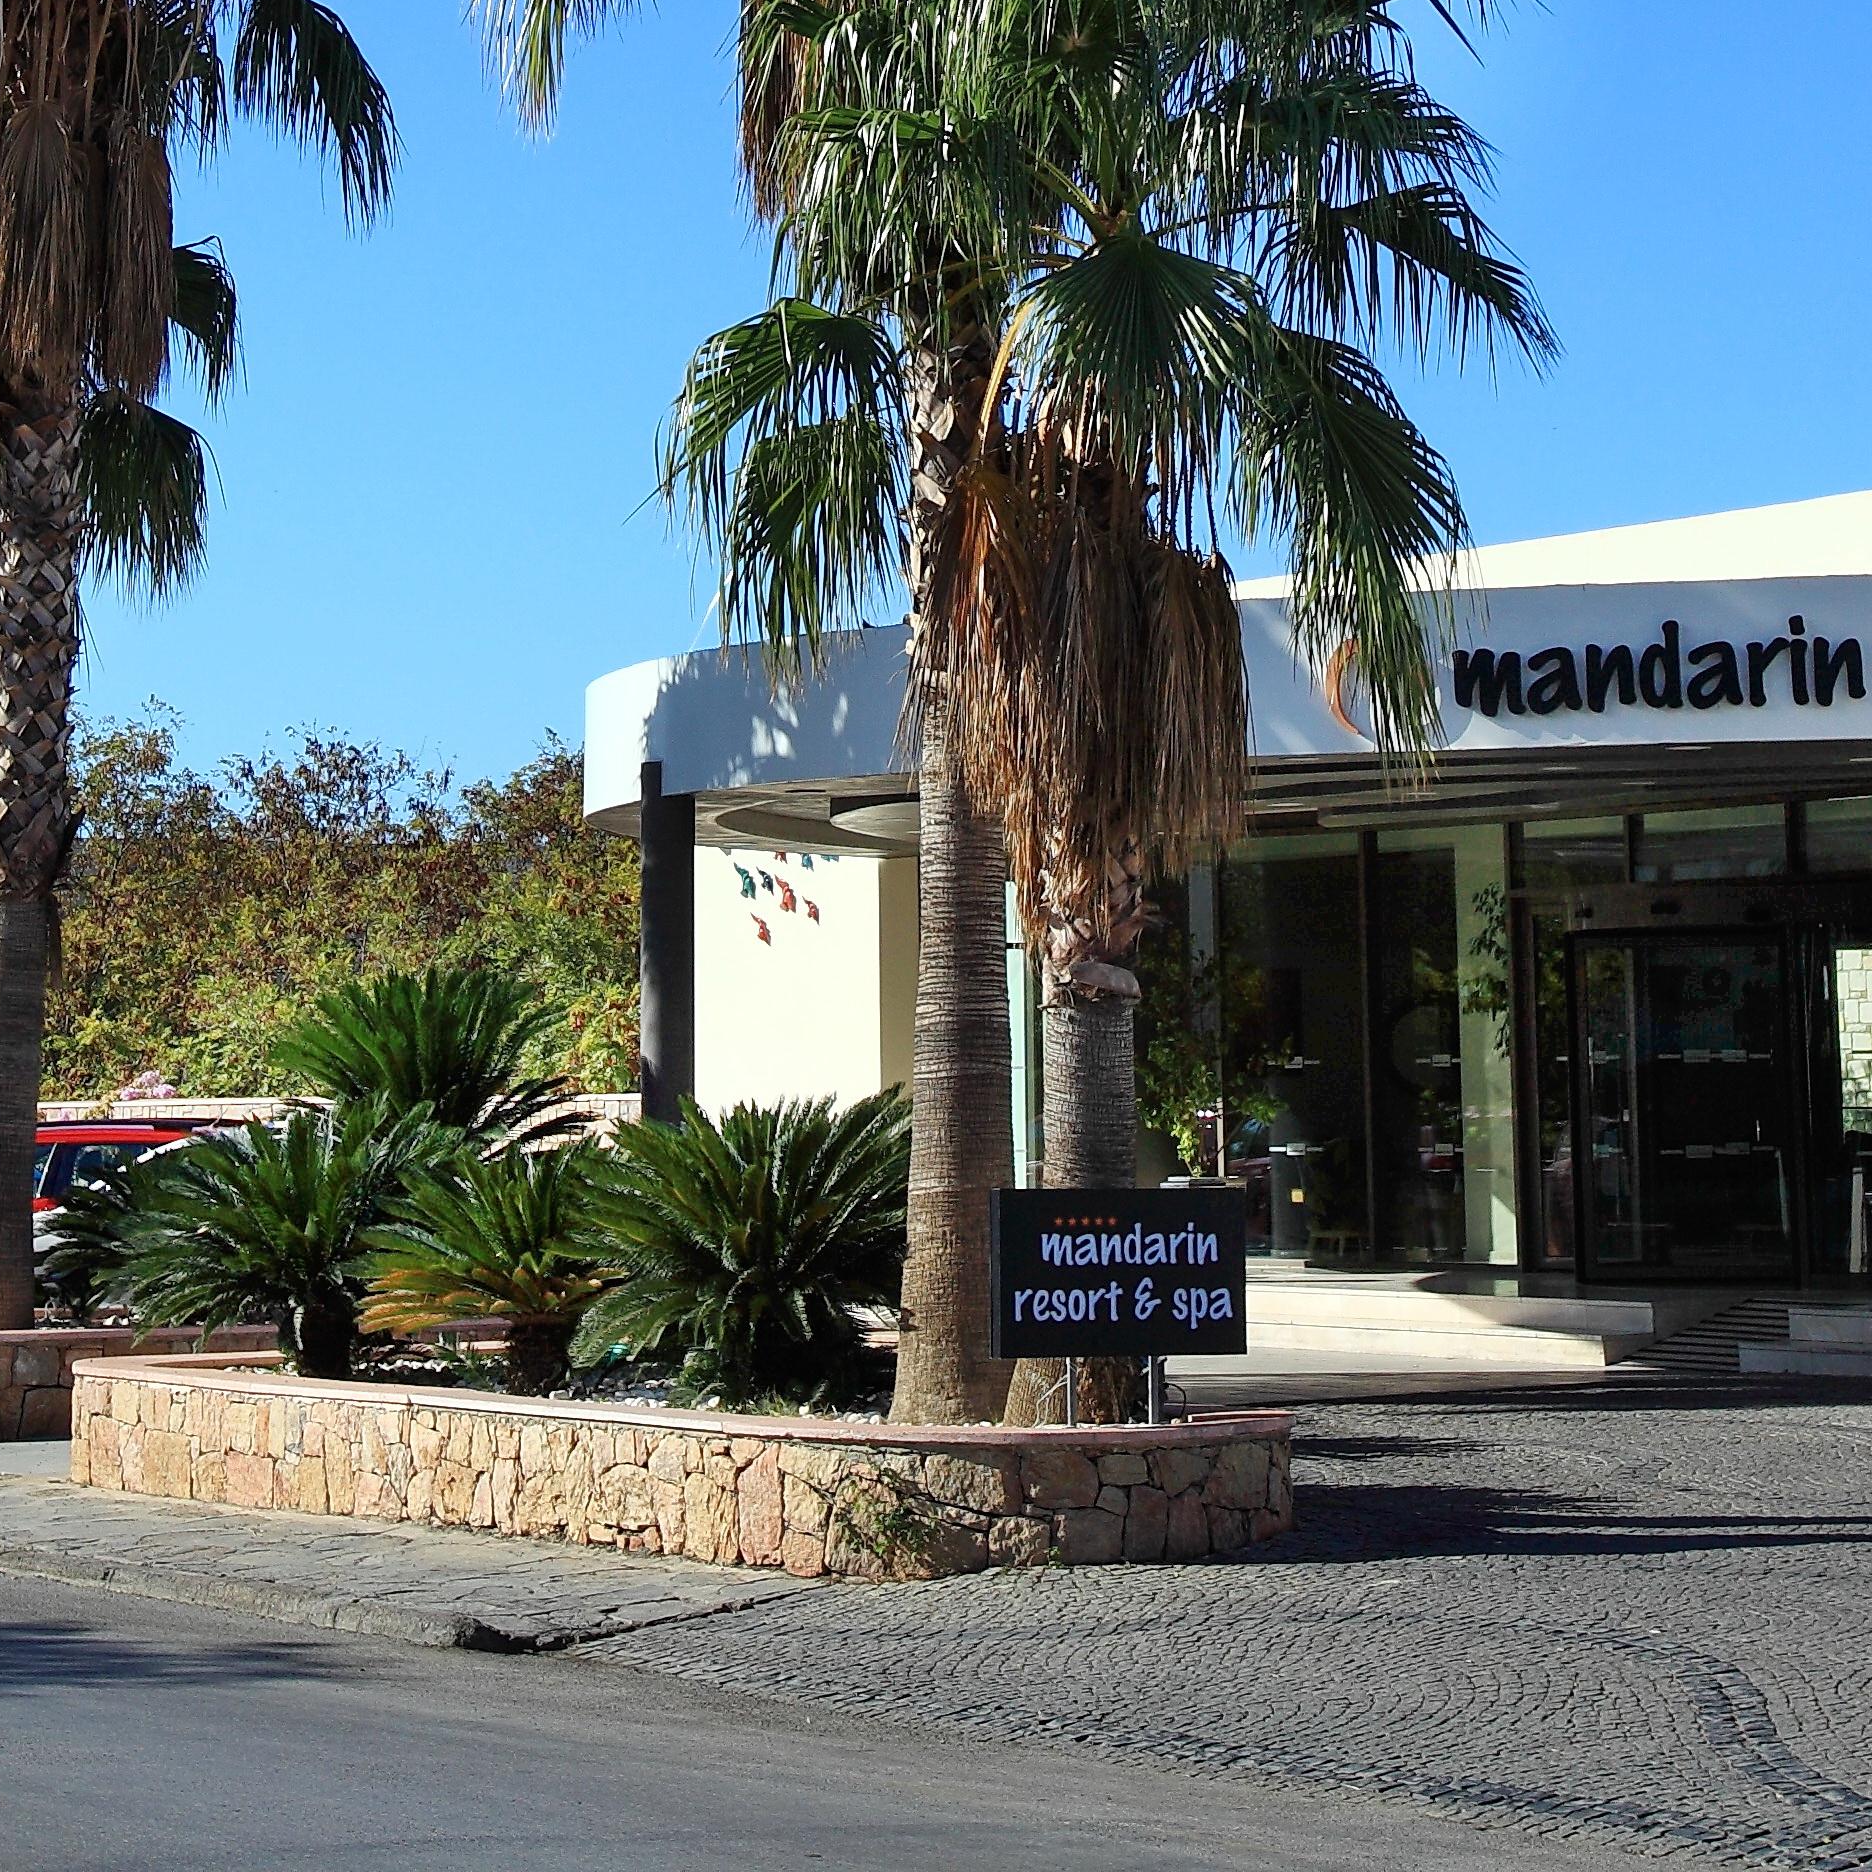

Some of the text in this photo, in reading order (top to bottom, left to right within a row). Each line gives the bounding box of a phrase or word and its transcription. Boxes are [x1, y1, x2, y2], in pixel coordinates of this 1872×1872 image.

[1453, 614, 1866, 717] mandarin
[1040, 1221, 1219, 1266] mandarin
[1013, 1277, 1234, 1330] resort & spa
